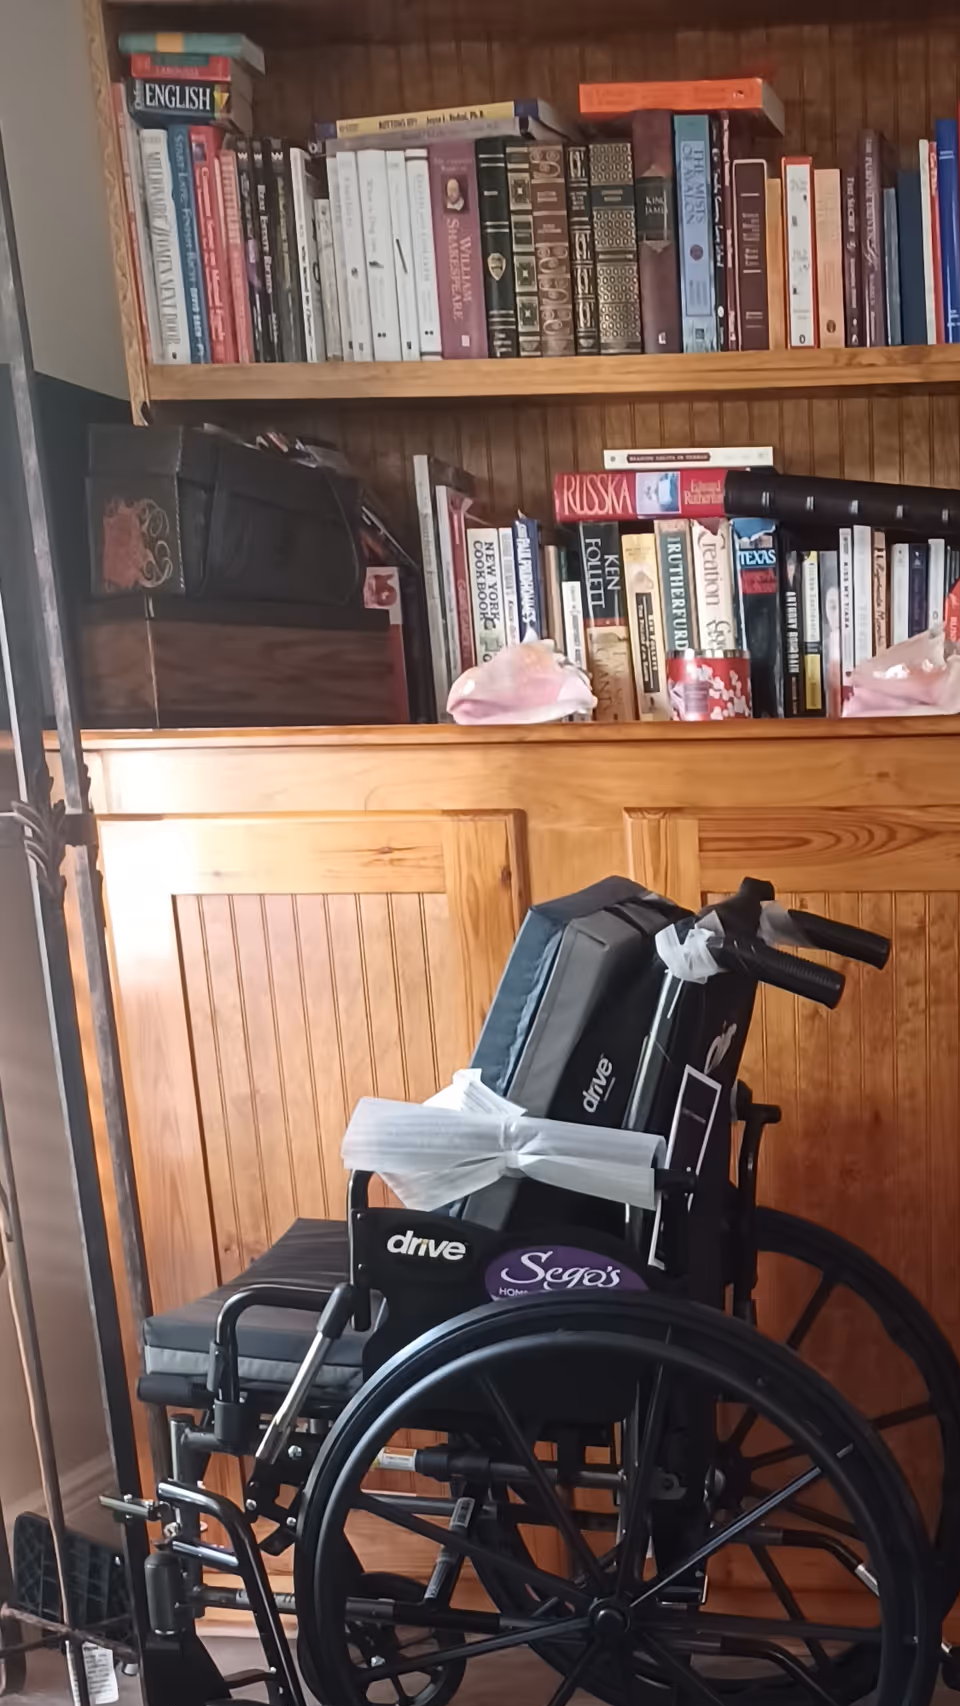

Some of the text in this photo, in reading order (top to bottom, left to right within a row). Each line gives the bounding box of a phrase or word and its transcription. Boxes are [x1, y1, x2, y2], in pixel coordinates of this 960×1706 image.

[145, 83, 210, 110] ENGLISH
[683, 165, 694, 225] AVALON
[694, 150, 706, 224] THE MISTS
[446, 217, 464, 321] SHAKESPEARE
[458, 236, 471, 302] WILLIAM
[163, 313, 181, 345] DOOR
[563, 473, 634, 516] RUSSKA
[516, 537, 531, 560] PAUL
[585, 537, 605, 609] FOLLETT
[604, 554, 621, 591] KEN
[698, 531, 726, 606] Creation
[739, 549, 776, 565] TEXAS
[484, 541, 500, 622] NEW YORK
[666, 543, 689, 650] RUTHERFURD
[786, 591, 798, 630] ANTHONY
[583, 1058, 613, 1113] drive
[387, 1230, 466, 1261] drive
[500, 1250, 621, 1291] Sego's
